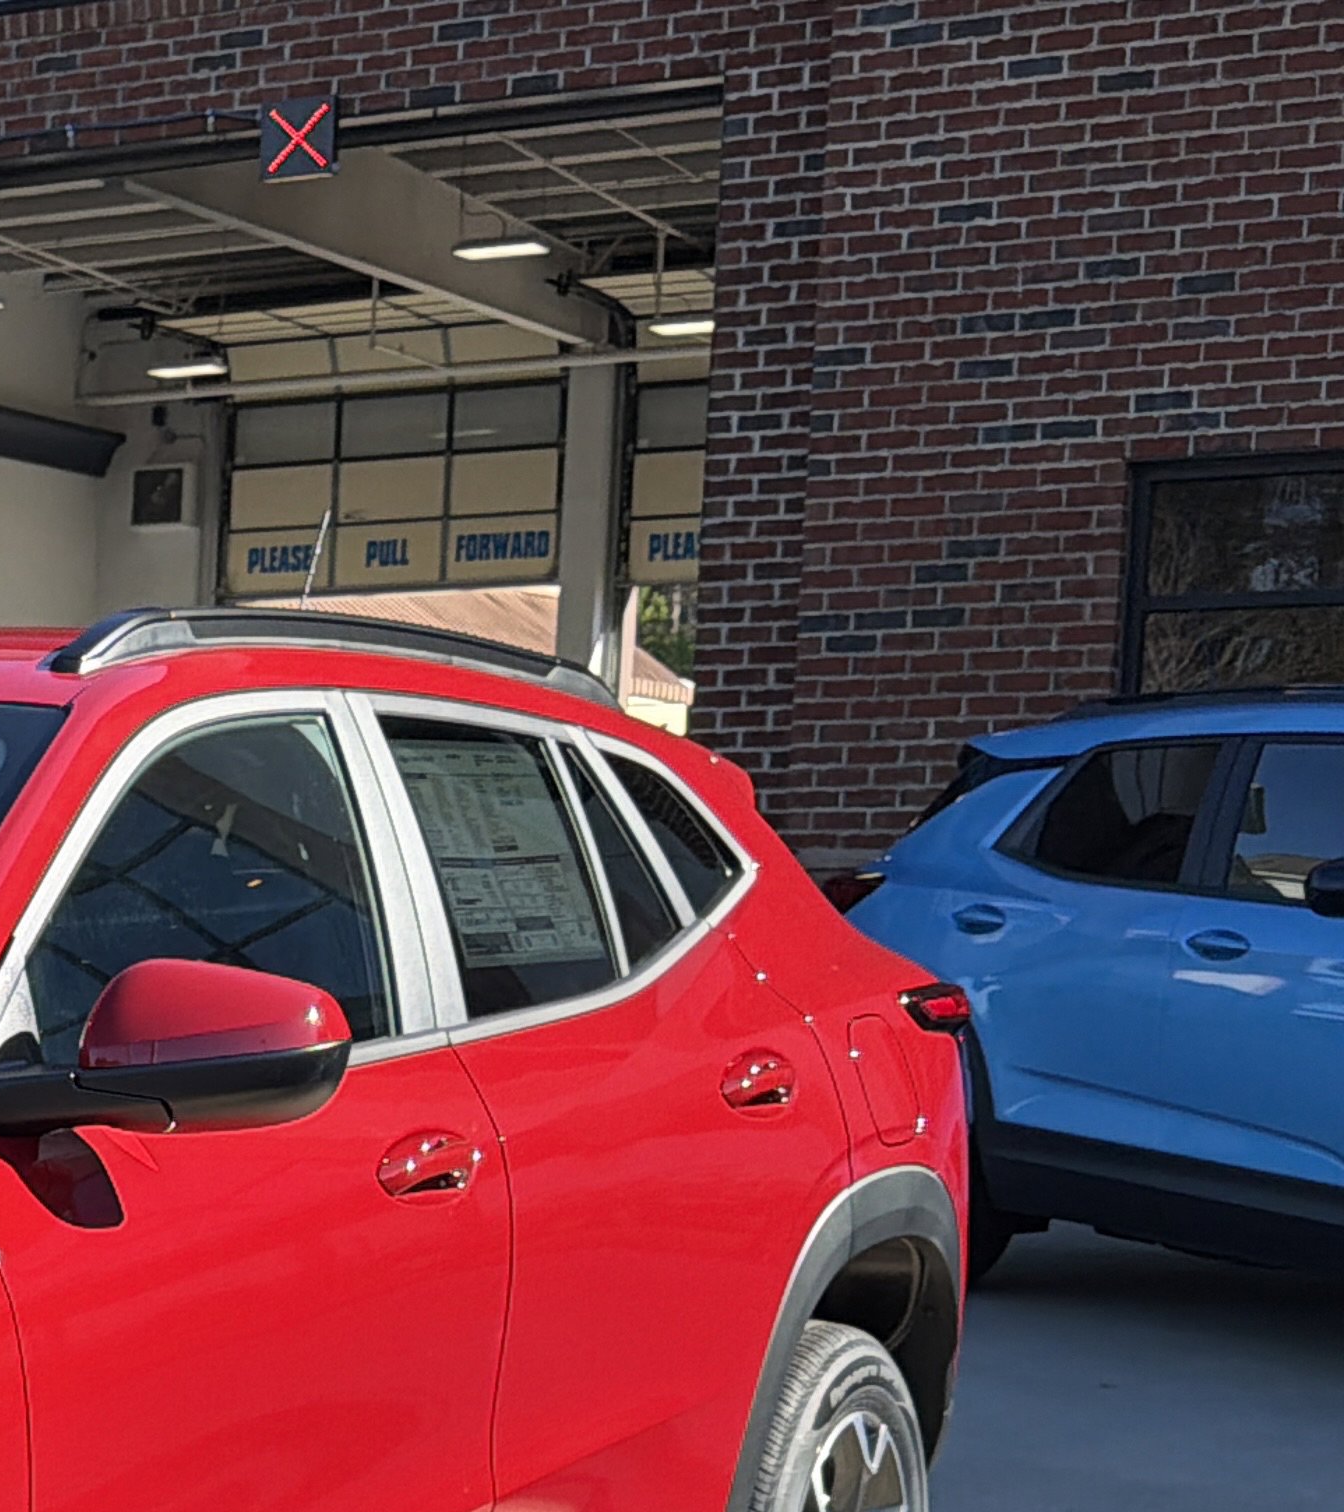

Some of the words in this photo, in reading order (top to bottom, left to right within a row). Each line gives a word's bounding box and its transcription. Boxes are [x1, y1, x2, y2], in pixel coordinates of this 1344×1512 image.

[247, 544, 314, 574] PLEASE
[365, 538, 409, 568] PULL
[454, 530, 550, 562] FORWARD
